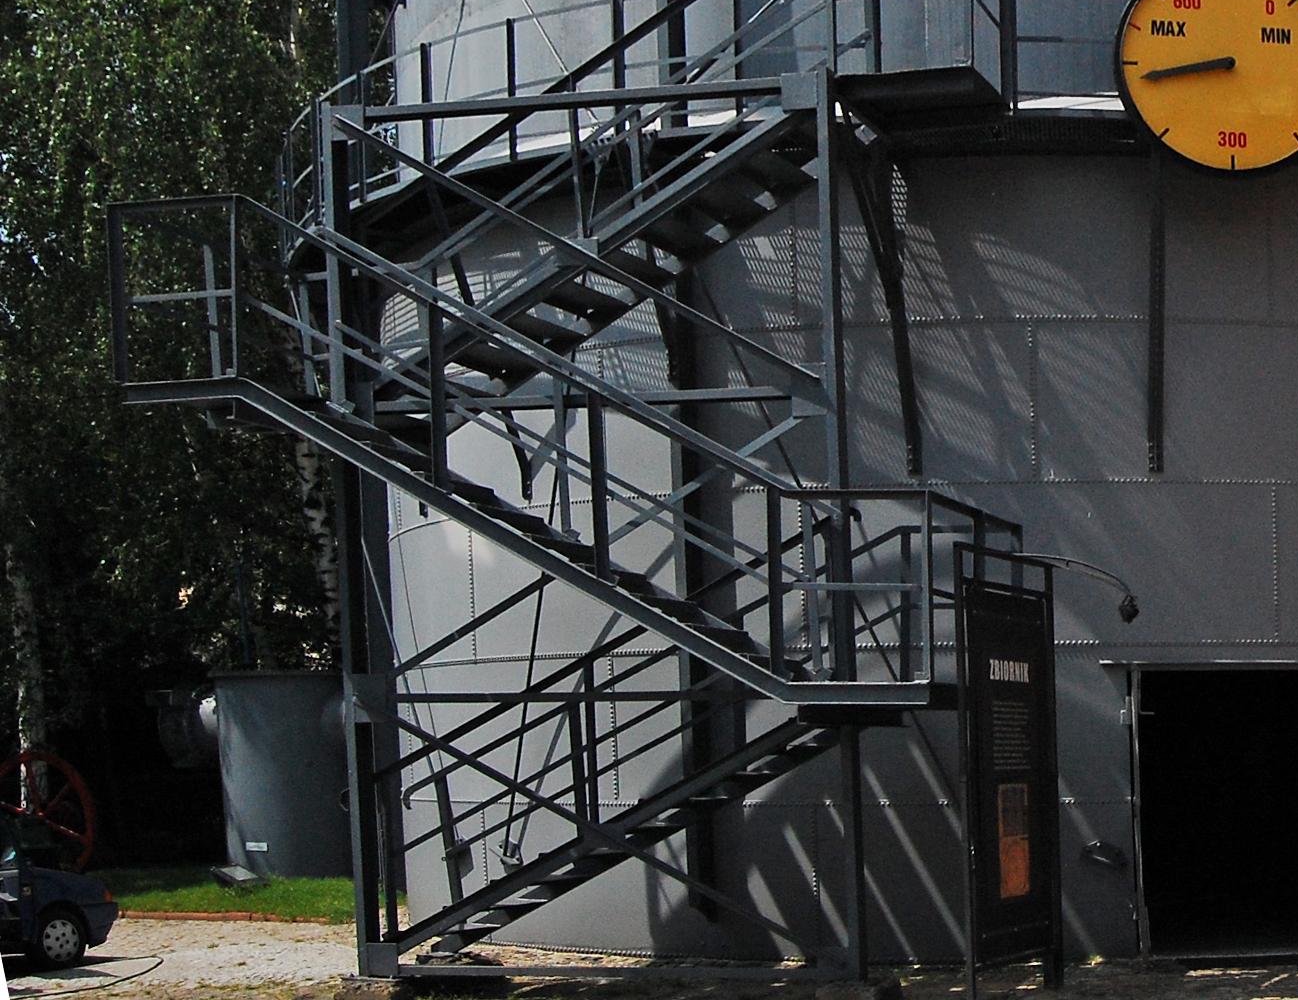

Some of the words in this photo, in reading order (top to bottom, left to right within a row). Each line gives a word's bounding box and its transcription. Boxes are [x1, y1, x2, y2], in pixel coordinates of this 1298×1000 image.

[1265, 0, 1275, 16] 0
[1151, 20, 1187, 37] MAX
[1261, 27, 1292, 45] MIN
[1218, 131, 1248, 149] 300
[989, 658, 1029, 683] ZBIORNIK
